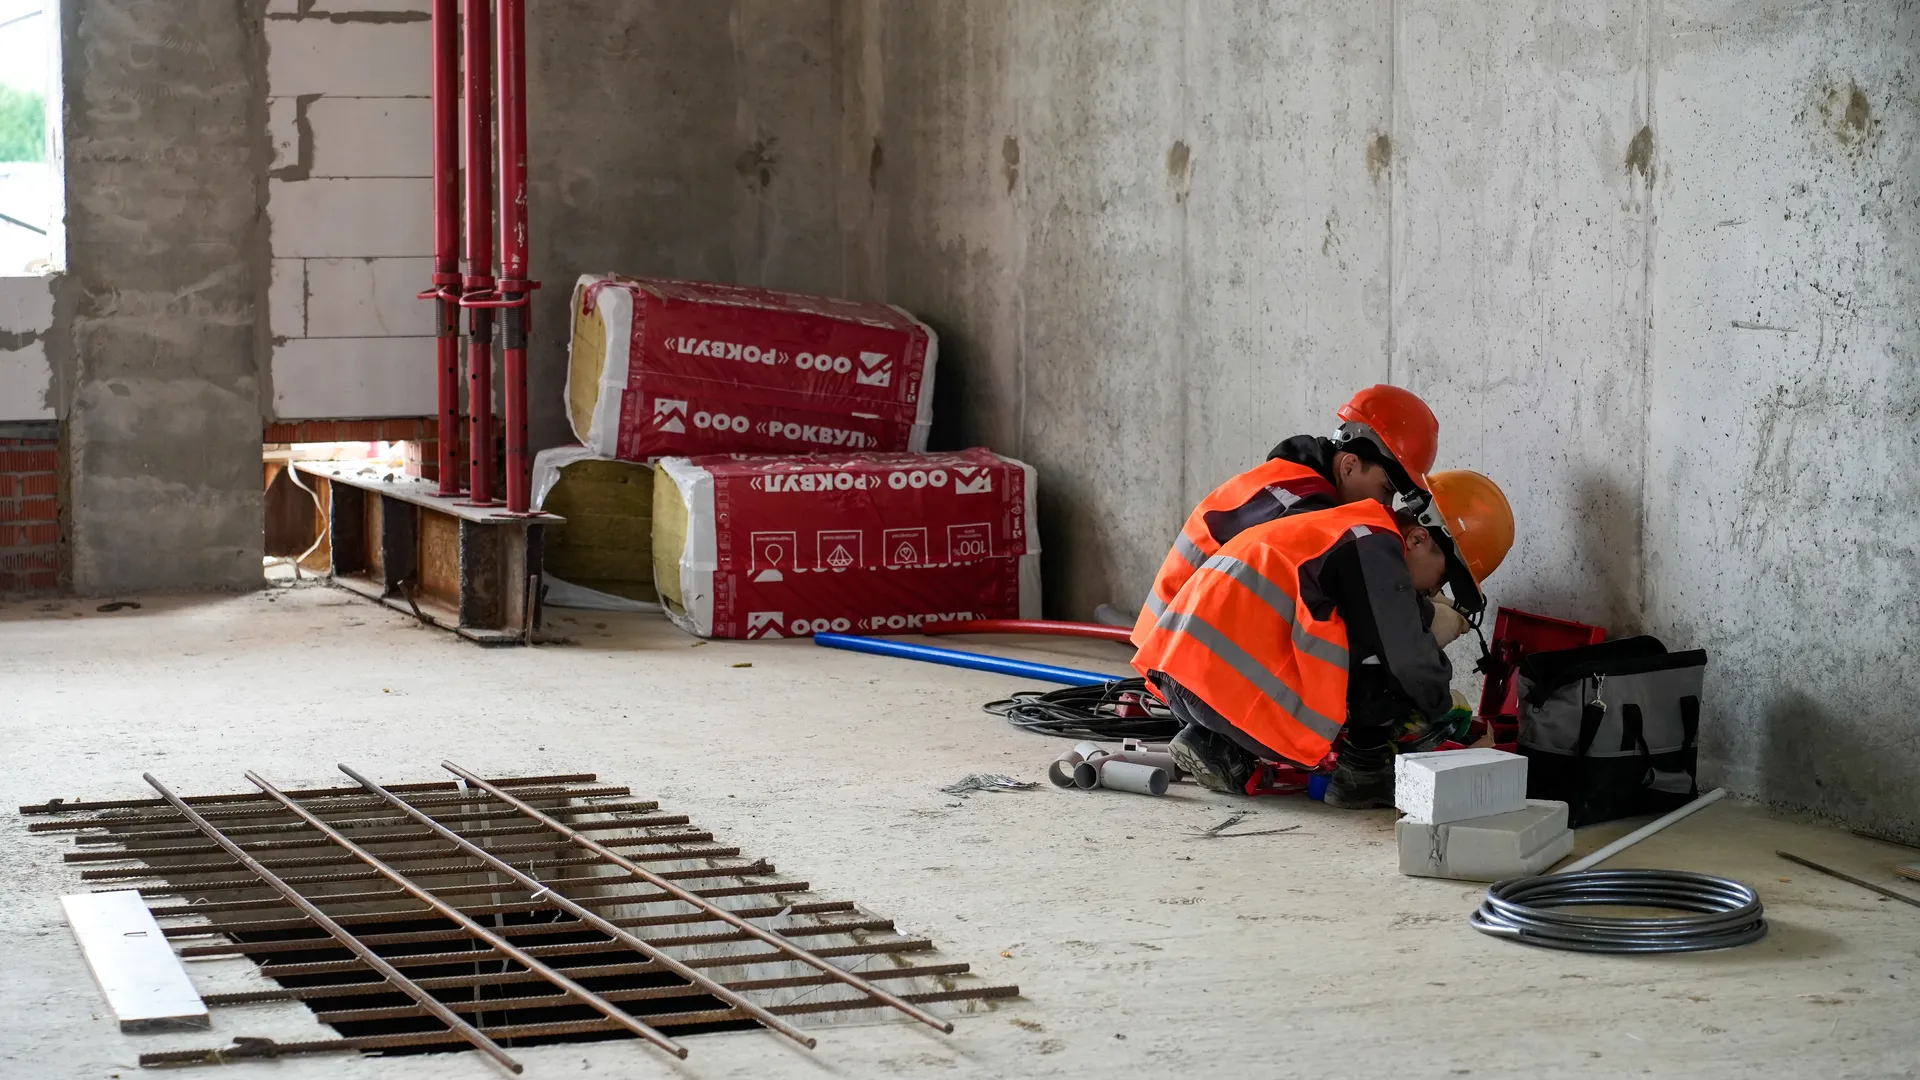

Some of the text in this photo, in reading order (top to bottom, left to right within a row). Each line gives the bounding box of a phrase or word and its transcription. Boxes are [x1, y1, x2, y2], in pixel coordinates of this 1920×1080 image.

[664, 337, 852, 374] ООО «РОКВУЛ»
[693, 411, 878, 448] ООО «РОКВУЛ»
[750, 470, 948, 492] ООО «РОКВУЛ»
[790, 617, 852, 635] ООО
